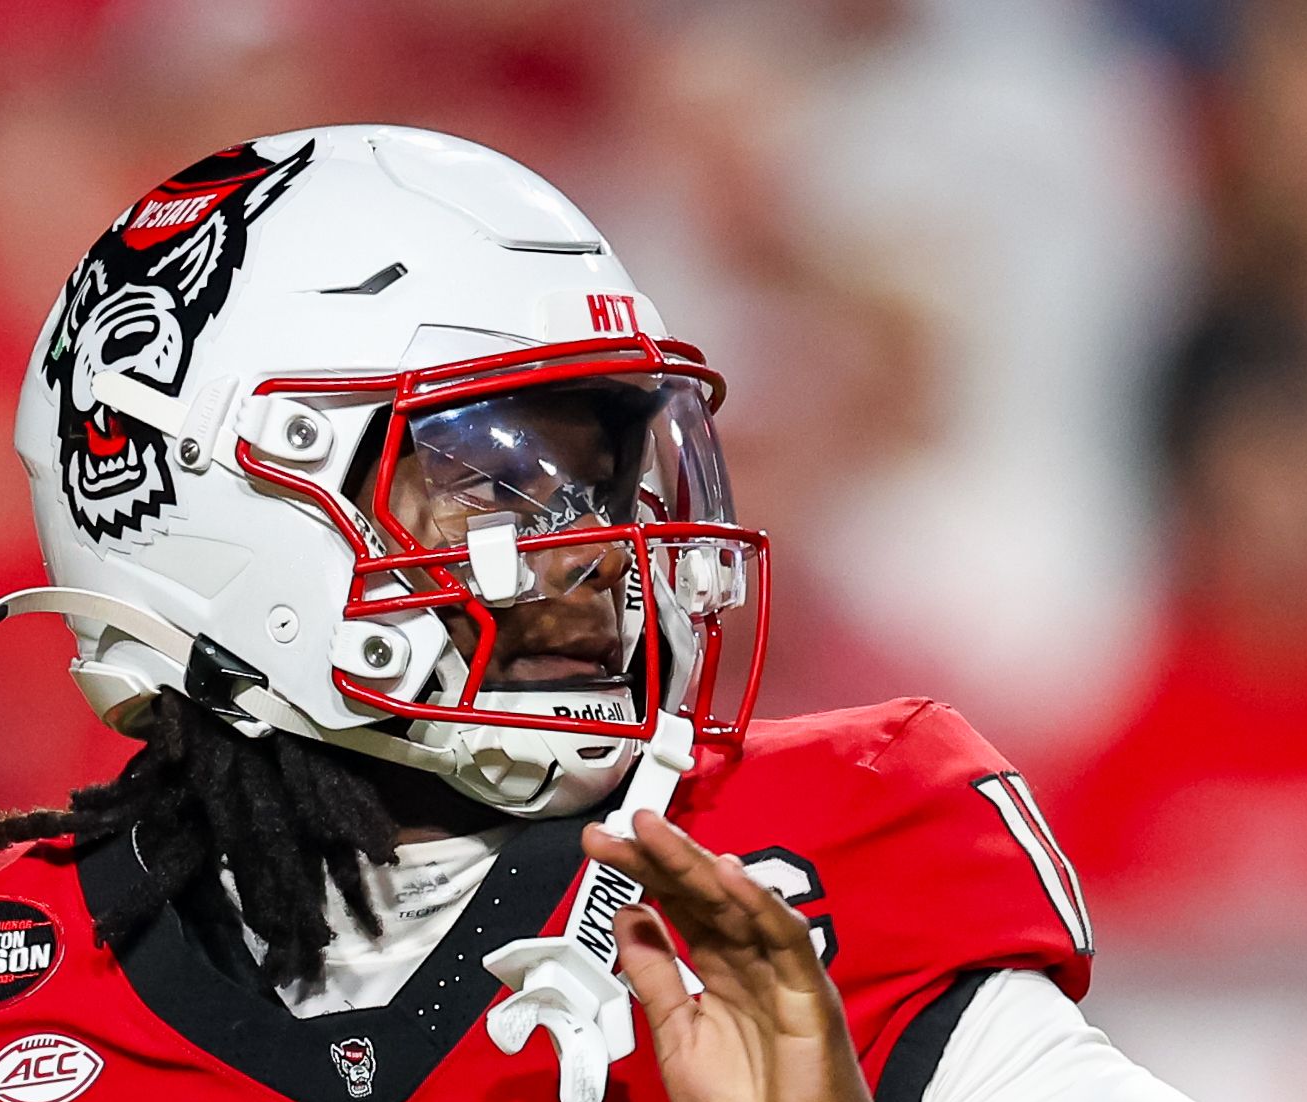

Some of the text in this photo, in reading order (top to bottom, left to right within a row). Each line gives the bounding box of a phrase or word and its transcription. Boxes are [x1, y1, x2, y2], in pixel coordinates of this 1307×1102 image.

[145, 193, 218, 229] STATE
[586, 293, 639, 333] HTT
[575, 864, 637, 964] NXTRN
[1, 1050, 82, 1085] ACC
